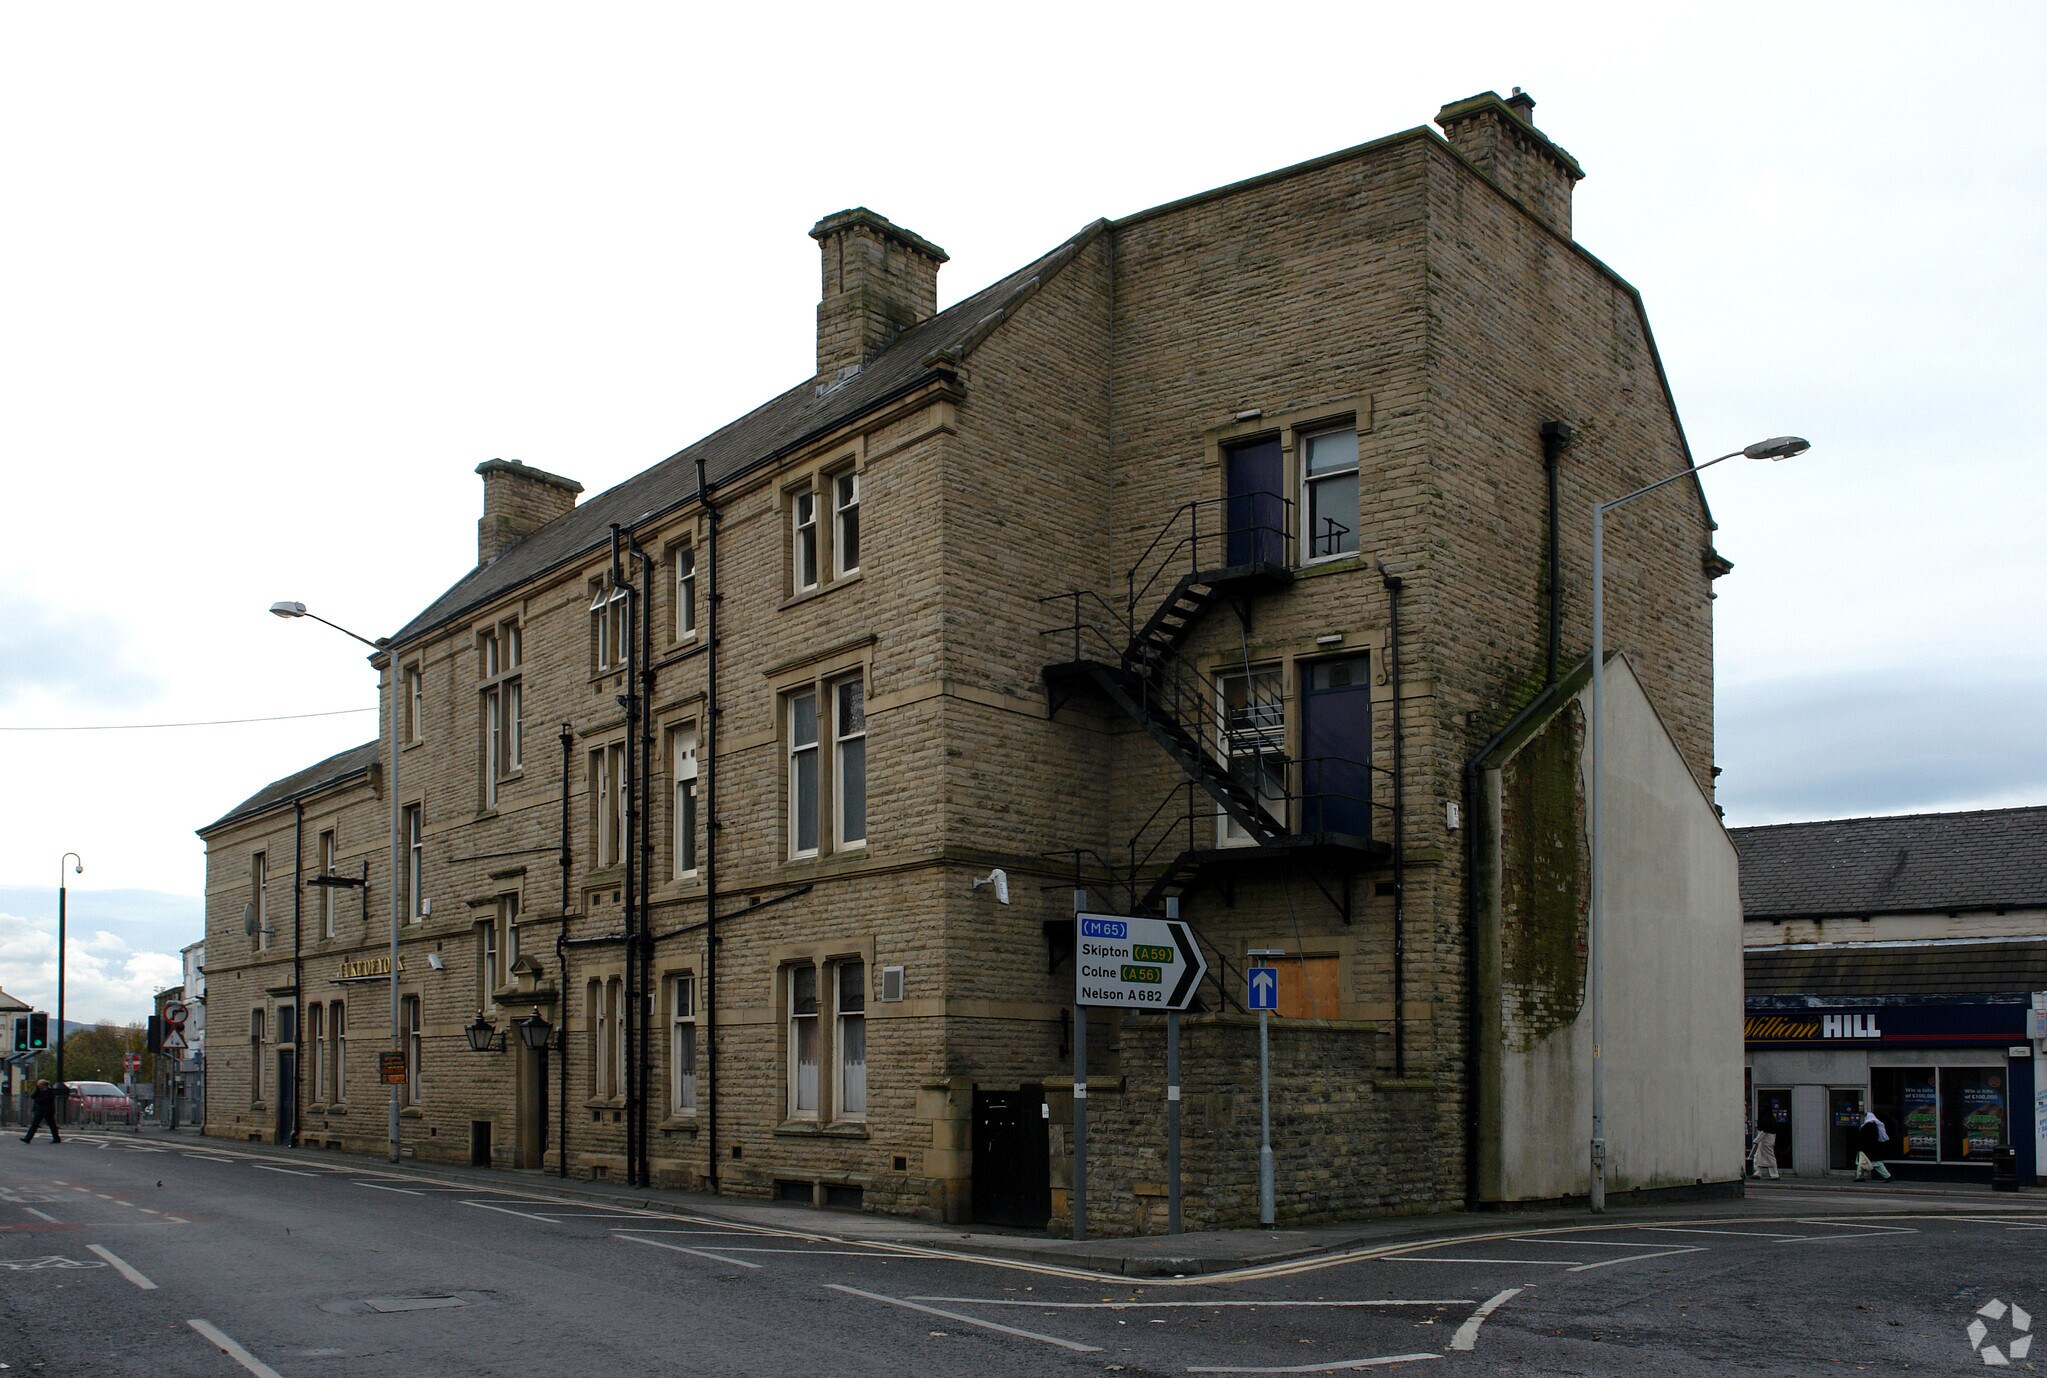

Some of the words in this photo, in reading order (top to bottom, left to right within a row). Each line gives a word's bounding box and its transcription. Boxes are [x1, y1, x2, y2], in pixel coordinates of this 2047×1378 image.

[1082, 943, 1129, 958] Skipton
[375, 955, 405, 974] YOK
[1081, 965, 1117, 978] Colne
[1082, 987, 1124, 1000] Nelson
[1128, 989, 1162, 1002] A682
[1823, 1014, 1881, 1038] HILL
